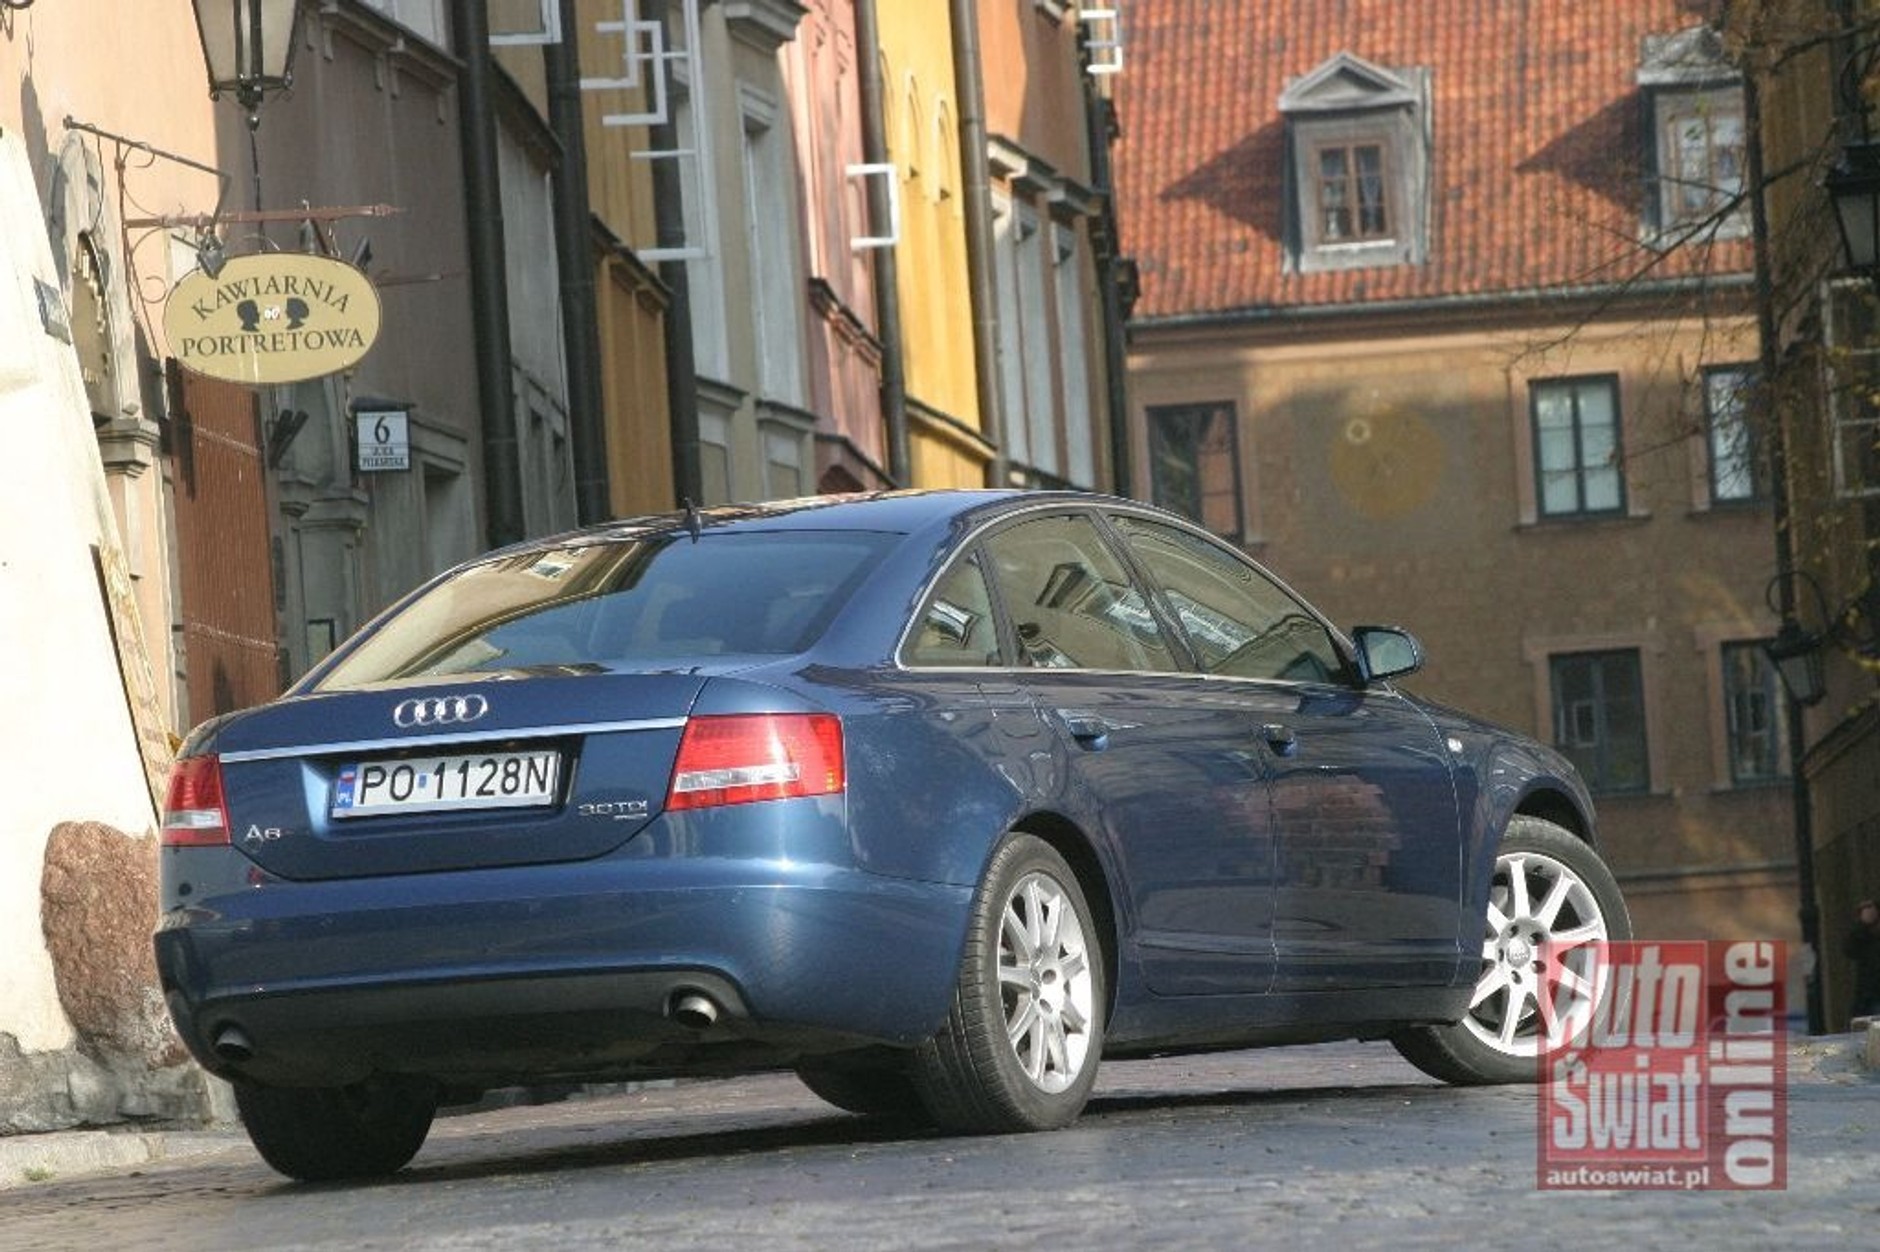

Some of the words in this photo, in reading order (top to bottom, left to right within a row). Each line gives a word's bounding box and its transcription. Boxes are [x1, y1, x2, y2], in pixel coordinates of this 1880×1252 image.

[191, 275, 350, 321] KAWIARNIA
[181, 327, 367, 357] PORTRETOWA
[374, 415, 391, 445] 6
[359, 764, 416, 805] PO
[433, 754, 550, 800] 1128N
[244, 824, 281, 841] A6
